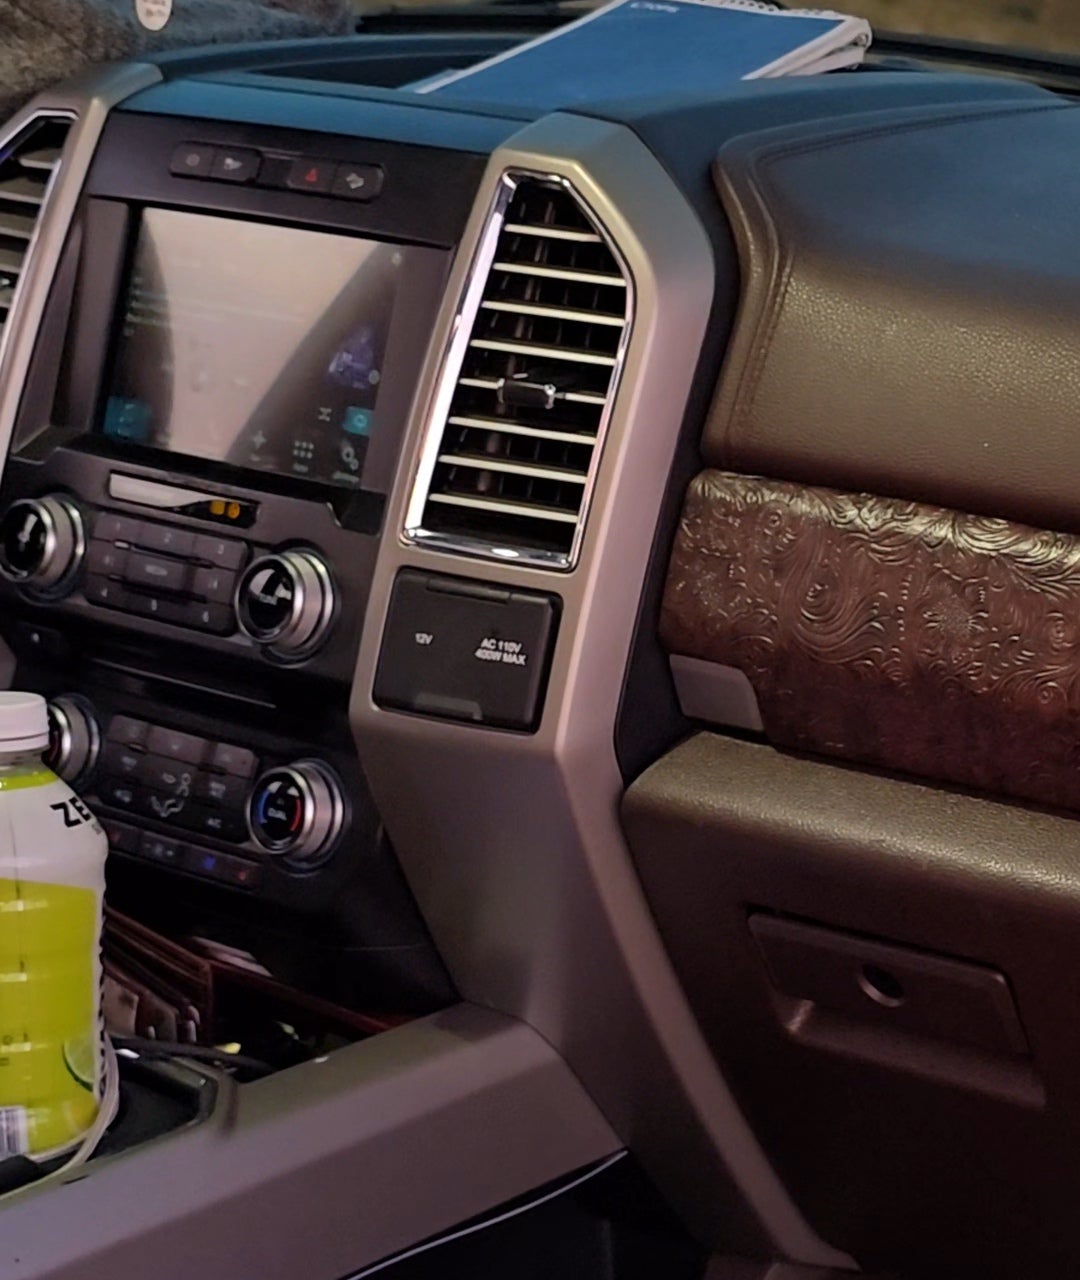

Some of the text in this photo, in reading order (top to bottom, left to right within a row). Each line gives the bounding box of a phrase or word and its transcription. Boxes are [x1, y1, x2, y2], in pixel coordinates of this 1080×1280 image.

[415, 632, 433, 645] 12V
[480, 638, 523, 653] AC 110V
[502, 652, 527, 666] MAX
[49, 796, 91, 828] ZE
